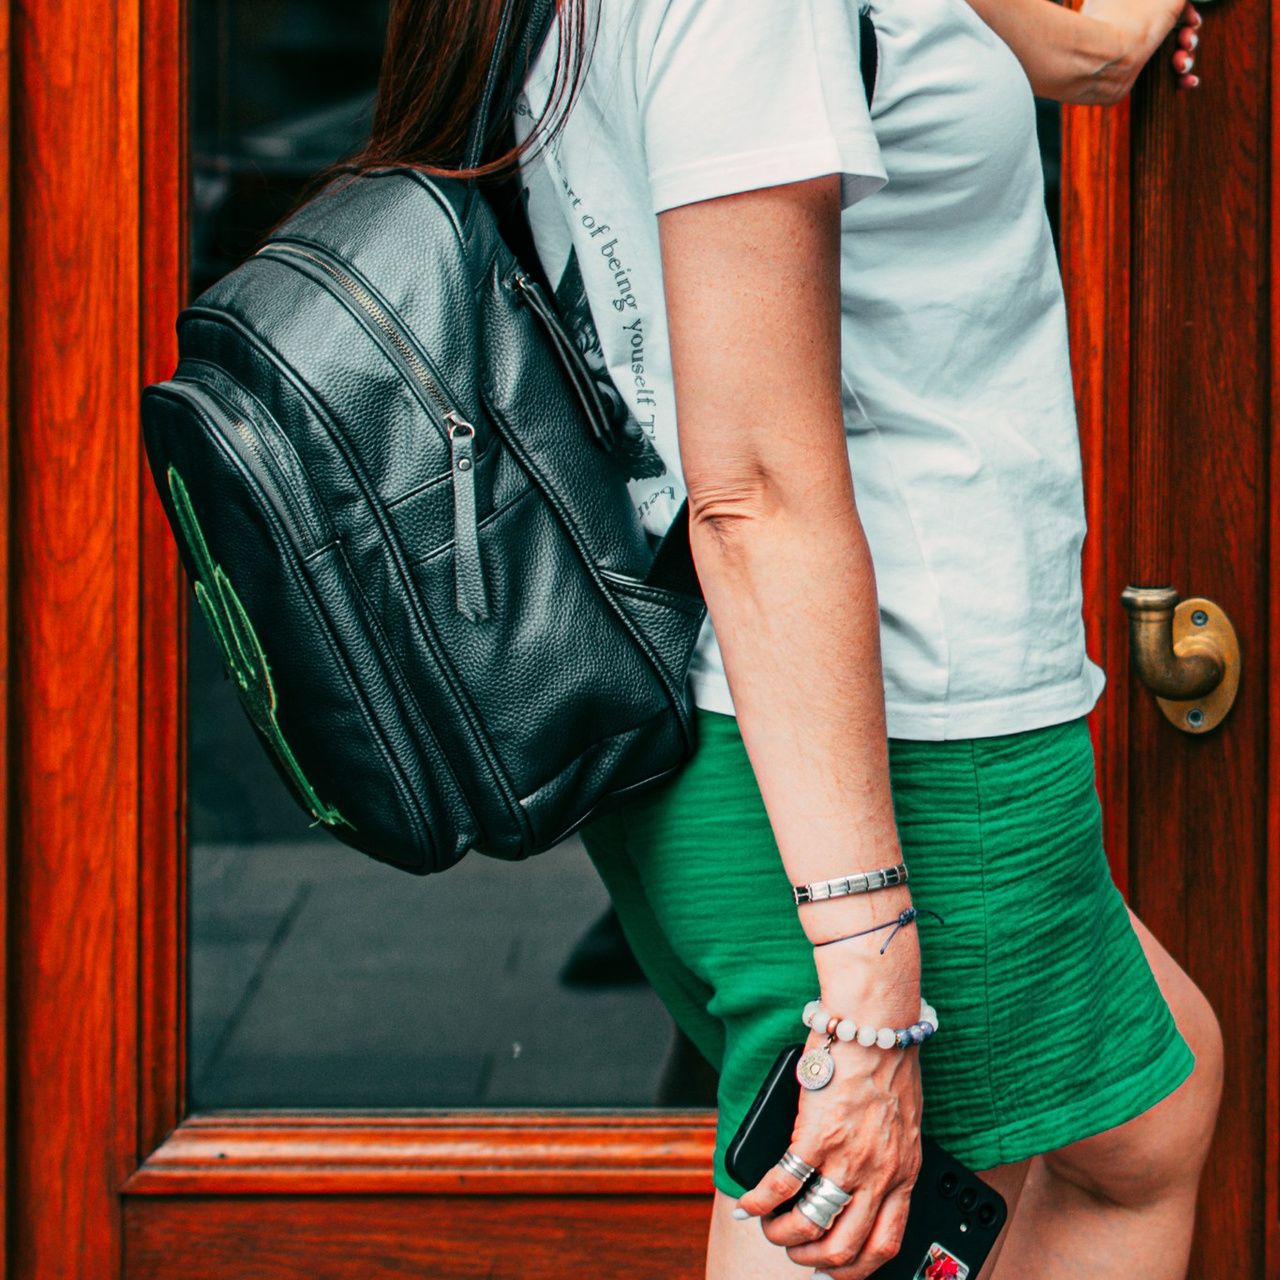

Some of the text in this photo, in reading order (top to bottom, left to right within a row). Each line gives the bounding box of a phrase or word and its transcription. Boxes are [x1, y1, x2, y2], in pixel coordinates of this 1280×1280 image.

[582, 214, 611, 238] of
[601, 238, 637, 312] being
[622, 318, 656, 407] youself
